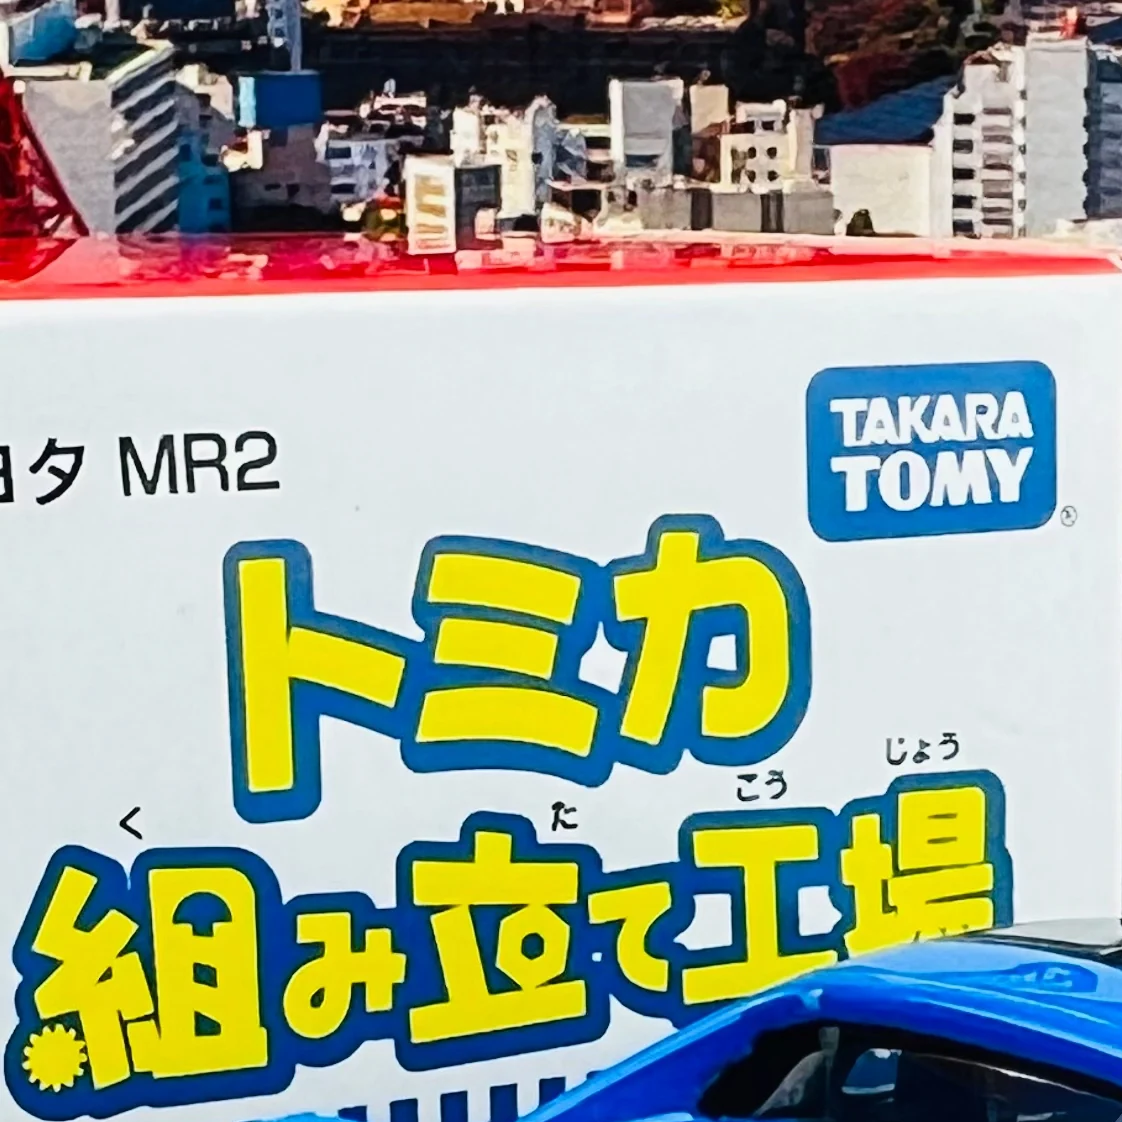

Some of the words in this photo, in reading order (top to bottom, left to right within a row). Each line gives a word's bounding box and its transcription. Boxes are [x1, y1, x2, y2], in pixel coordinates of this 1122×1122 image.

[830, 391, 1034, 448] TAKARA
[118, 430, 281, 497] MR2
[830, 447, 1034, 512] TOMY
[237, 531, 790, 794] トミカ
[886, 732, 960, 766] じょう
[736, 770, 788, 802] こう
[119, 806, 143, 839] く
[551, 801, 579, 831] た
